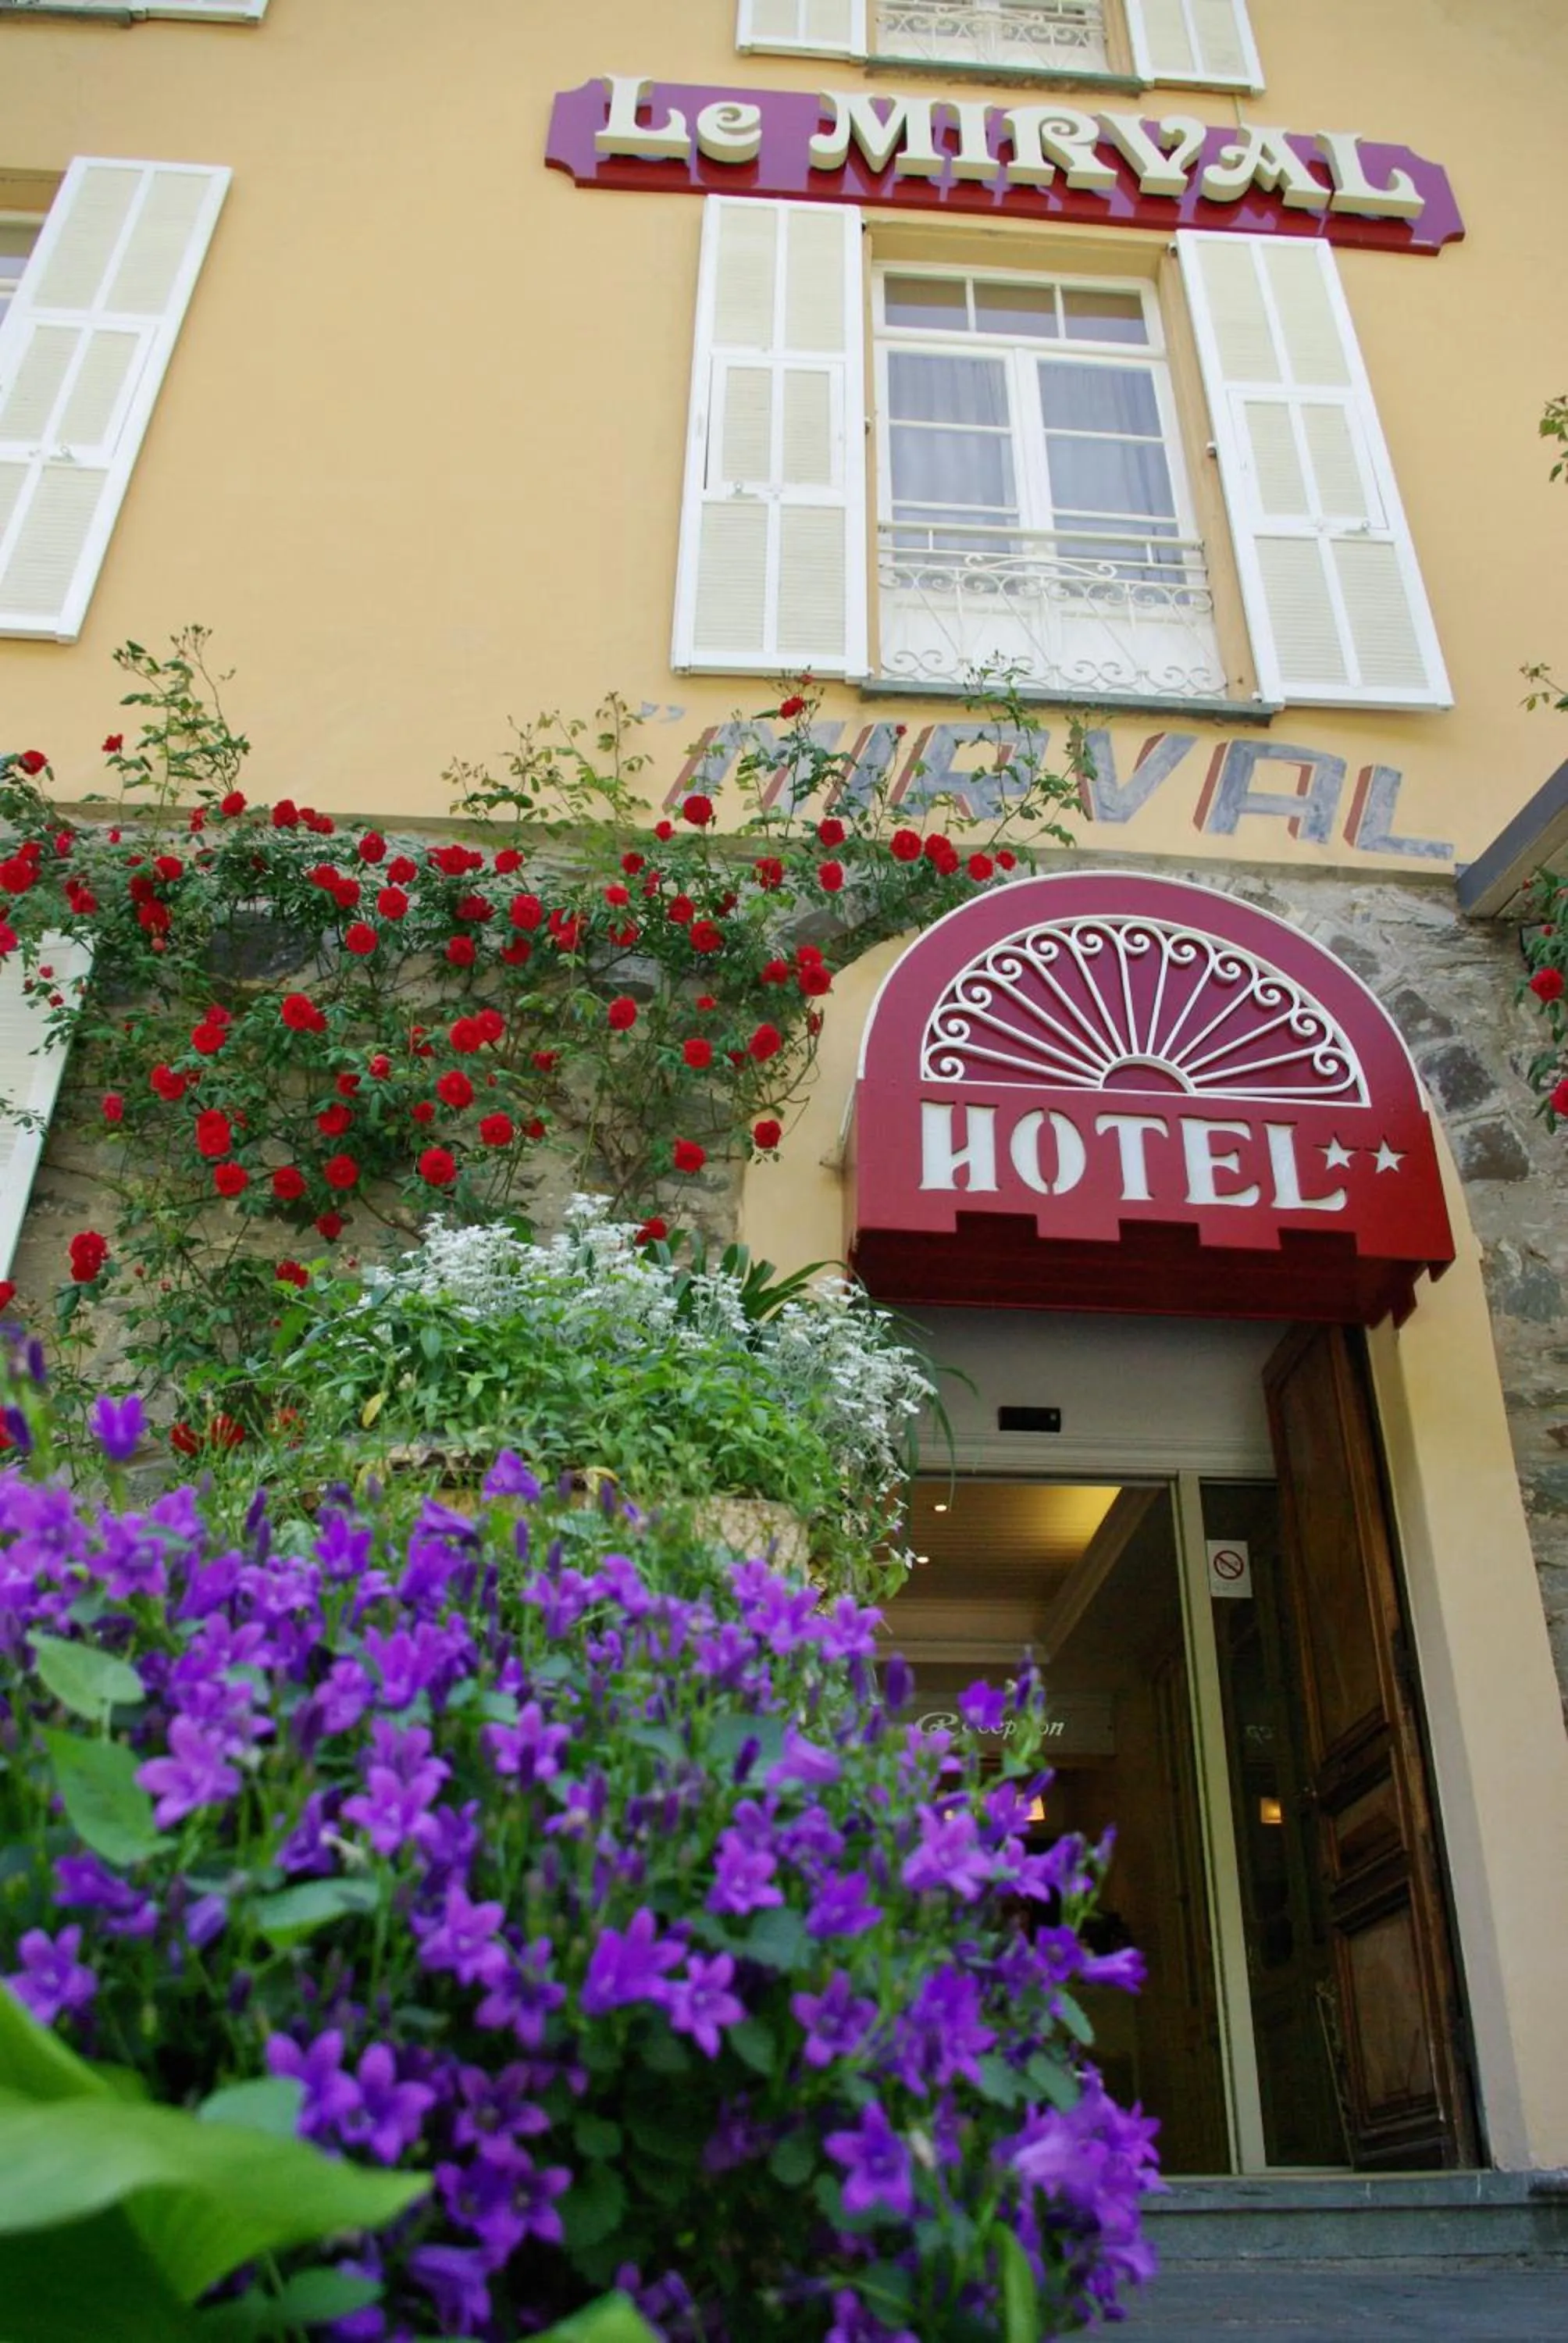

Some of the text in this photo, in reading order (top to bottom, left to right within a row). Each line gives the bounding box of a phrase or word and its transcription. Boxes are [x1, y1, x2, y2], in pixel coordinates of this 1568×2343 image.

[594, 75, 1424, 218] Le MIRVAL
[918, 1102, 1349, 1212] HOTEL
